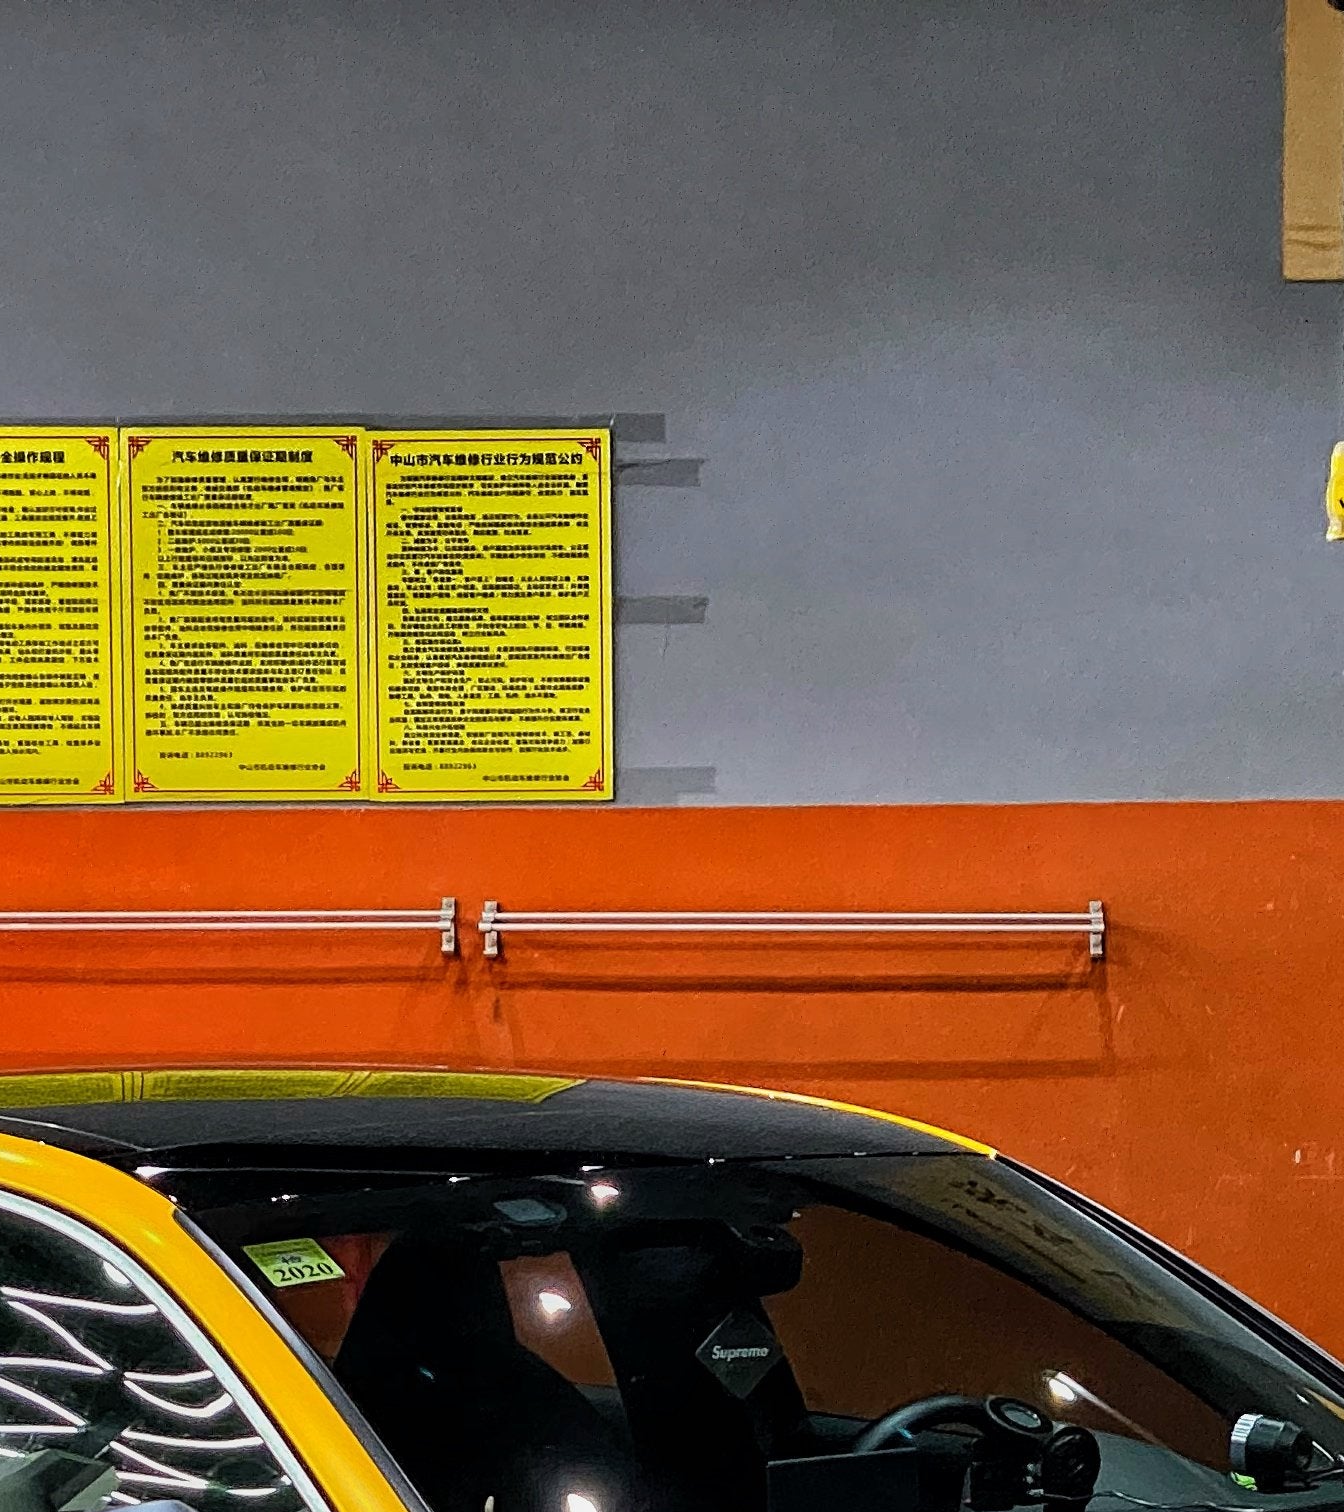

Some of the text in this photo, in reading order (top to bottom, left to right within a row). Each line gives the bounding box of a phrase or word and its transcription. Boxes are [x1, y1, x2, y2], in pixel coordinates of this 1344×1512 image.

[171, 450, 313, 463] 汽车维修质量保证期制度
[390, 453, 583, 467] 中山市汽车维修行业行为规范公约
[272, 1262, 334, 1283] 2020
[711, 1345, 770, 1362] Supreme
